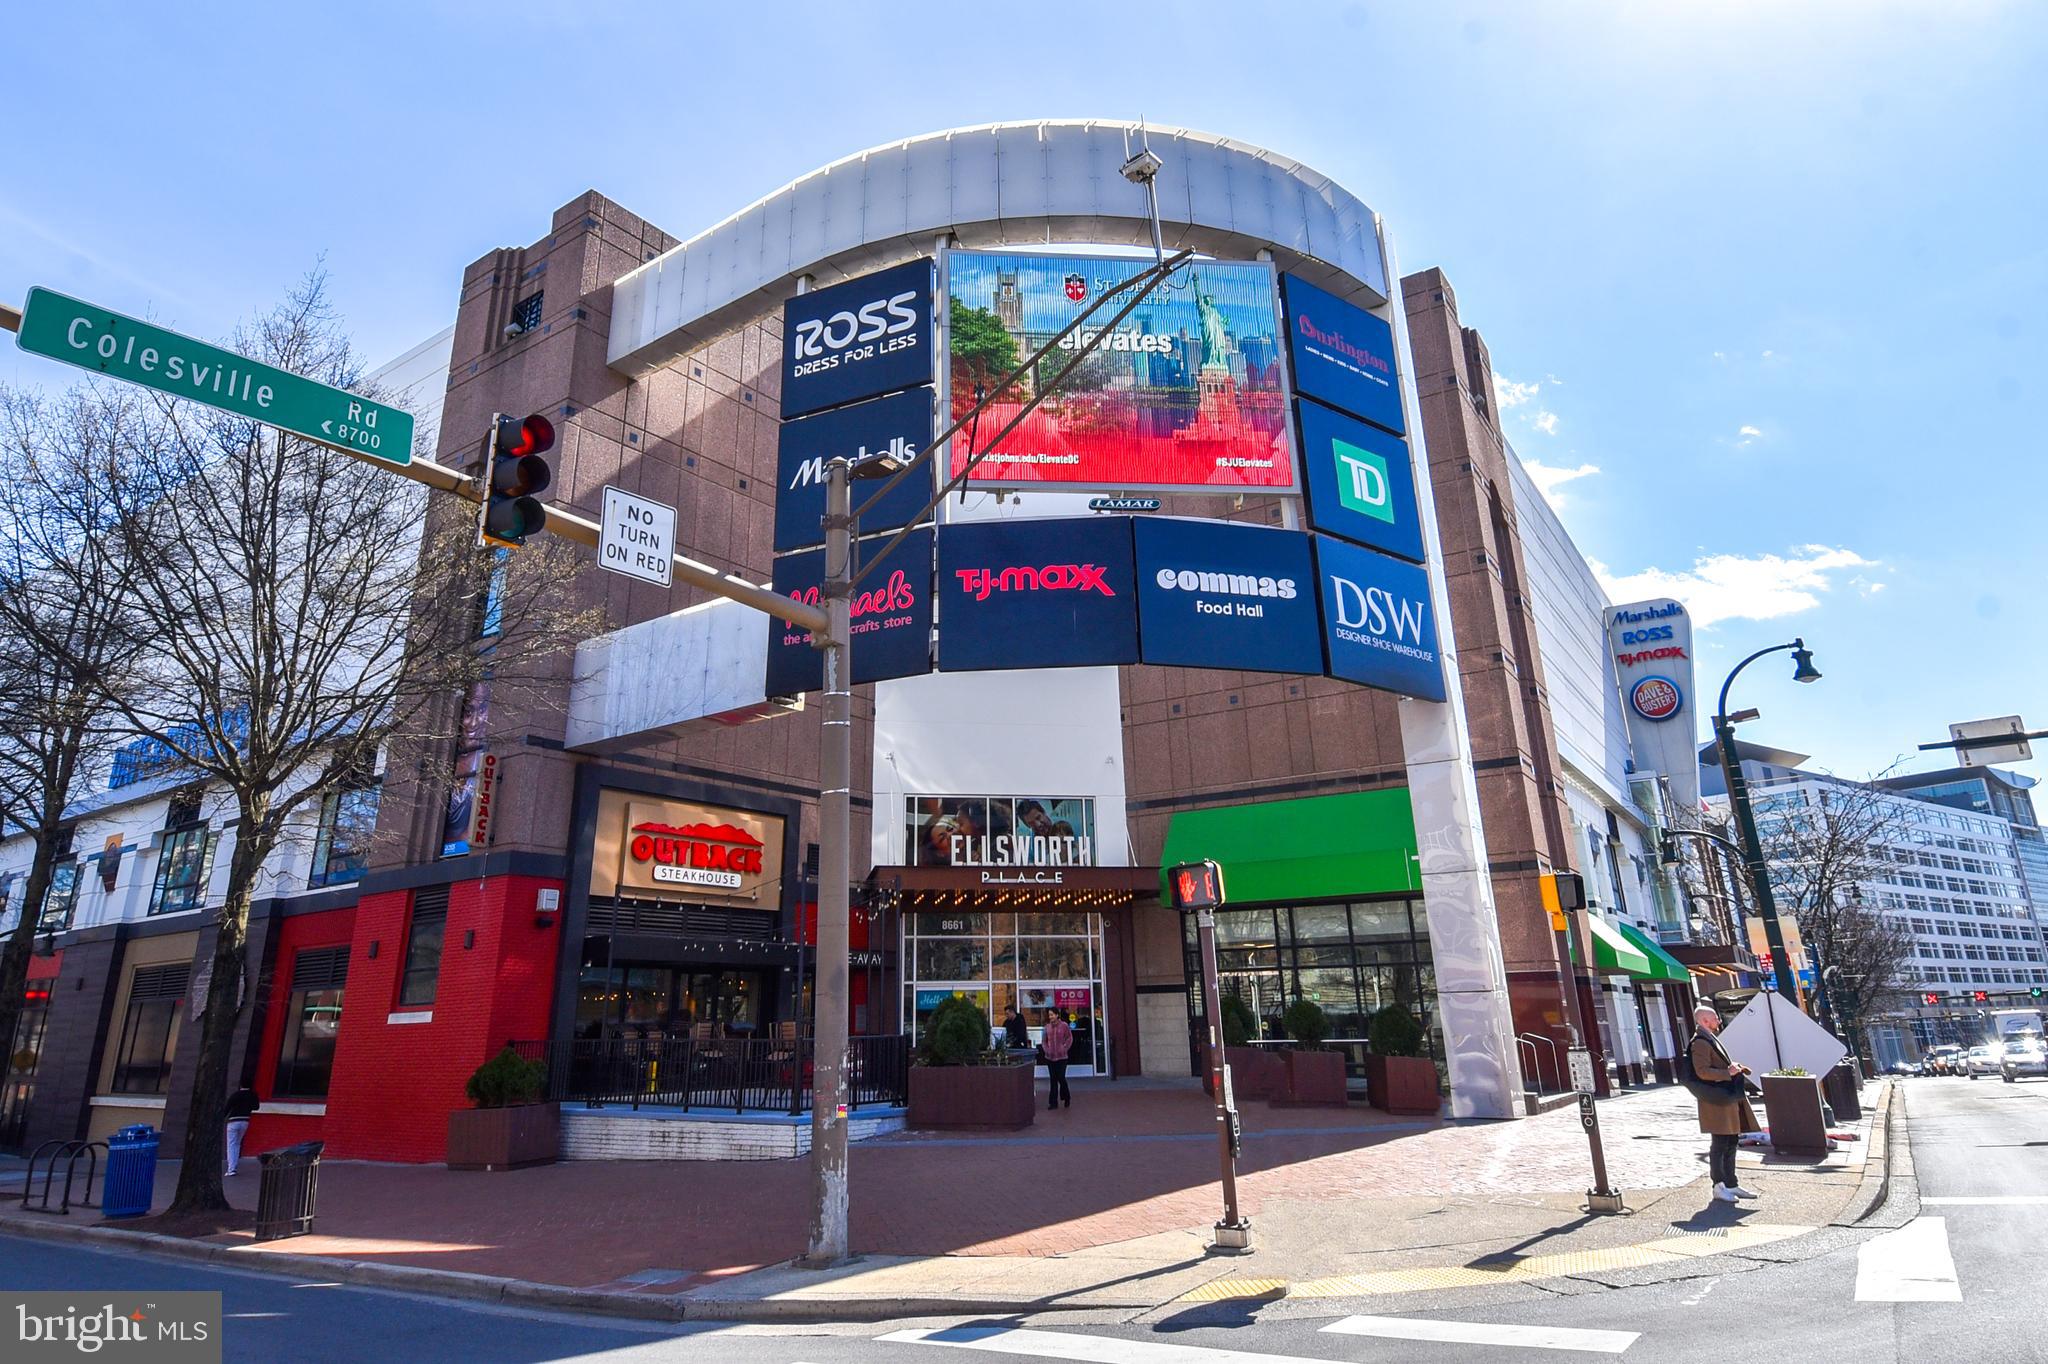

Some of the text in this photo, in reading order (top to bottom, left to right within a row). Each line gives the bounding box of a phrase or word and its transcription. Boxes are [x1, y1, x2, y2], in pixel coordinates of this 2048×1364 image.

[795, 290, 917, 360] ROSS
[1058, 317, 1172, 353] elevates
[794, 333, 917, 377] DRESS FOR LESS
[1299, 314, 1390, 374] Burlington
[67, 317, 274, 408] Colesville
[348, 402, 377, 428] Rd
[338, 424, 381, 448] 8700
[1340, 454, 1386, 506] TD
[627, 505, 654, 526] NO
[1094, 499, 1154, 508] LAMAR
[619, 523, 660, 550] TURN
[606, 543, 666, 573] ON RED
[1156, 568, 1297, 600] commas
[1196, 601, 1264, 618] Food Hall
[1330, 575, 1424, 646] DSW
[1612, 603, 1683, 627] Marshalls
[849, 615, 913, 635] crafts store
[1622, 625, 1674, 646] ROSS
[783, 634, 801, 646] the
[1336, 627, 1434, 662] DESIGNER SHOE WAREHOUSE
[1637, 683, 1672, 703] DAVE &
[1641, 692, 1676, 712] BUSTER'S
[475, 755, 496, 843] OUTBACK
[631, 834, 763, 874] OUTBACK
[951, 835, 1092, 867] ELLSWORTH
[660, 867, 736, 885] STEAKHOUSE
[981, 871, 1063, 884] PLACE
[941, 919, 964, 930] 8661
